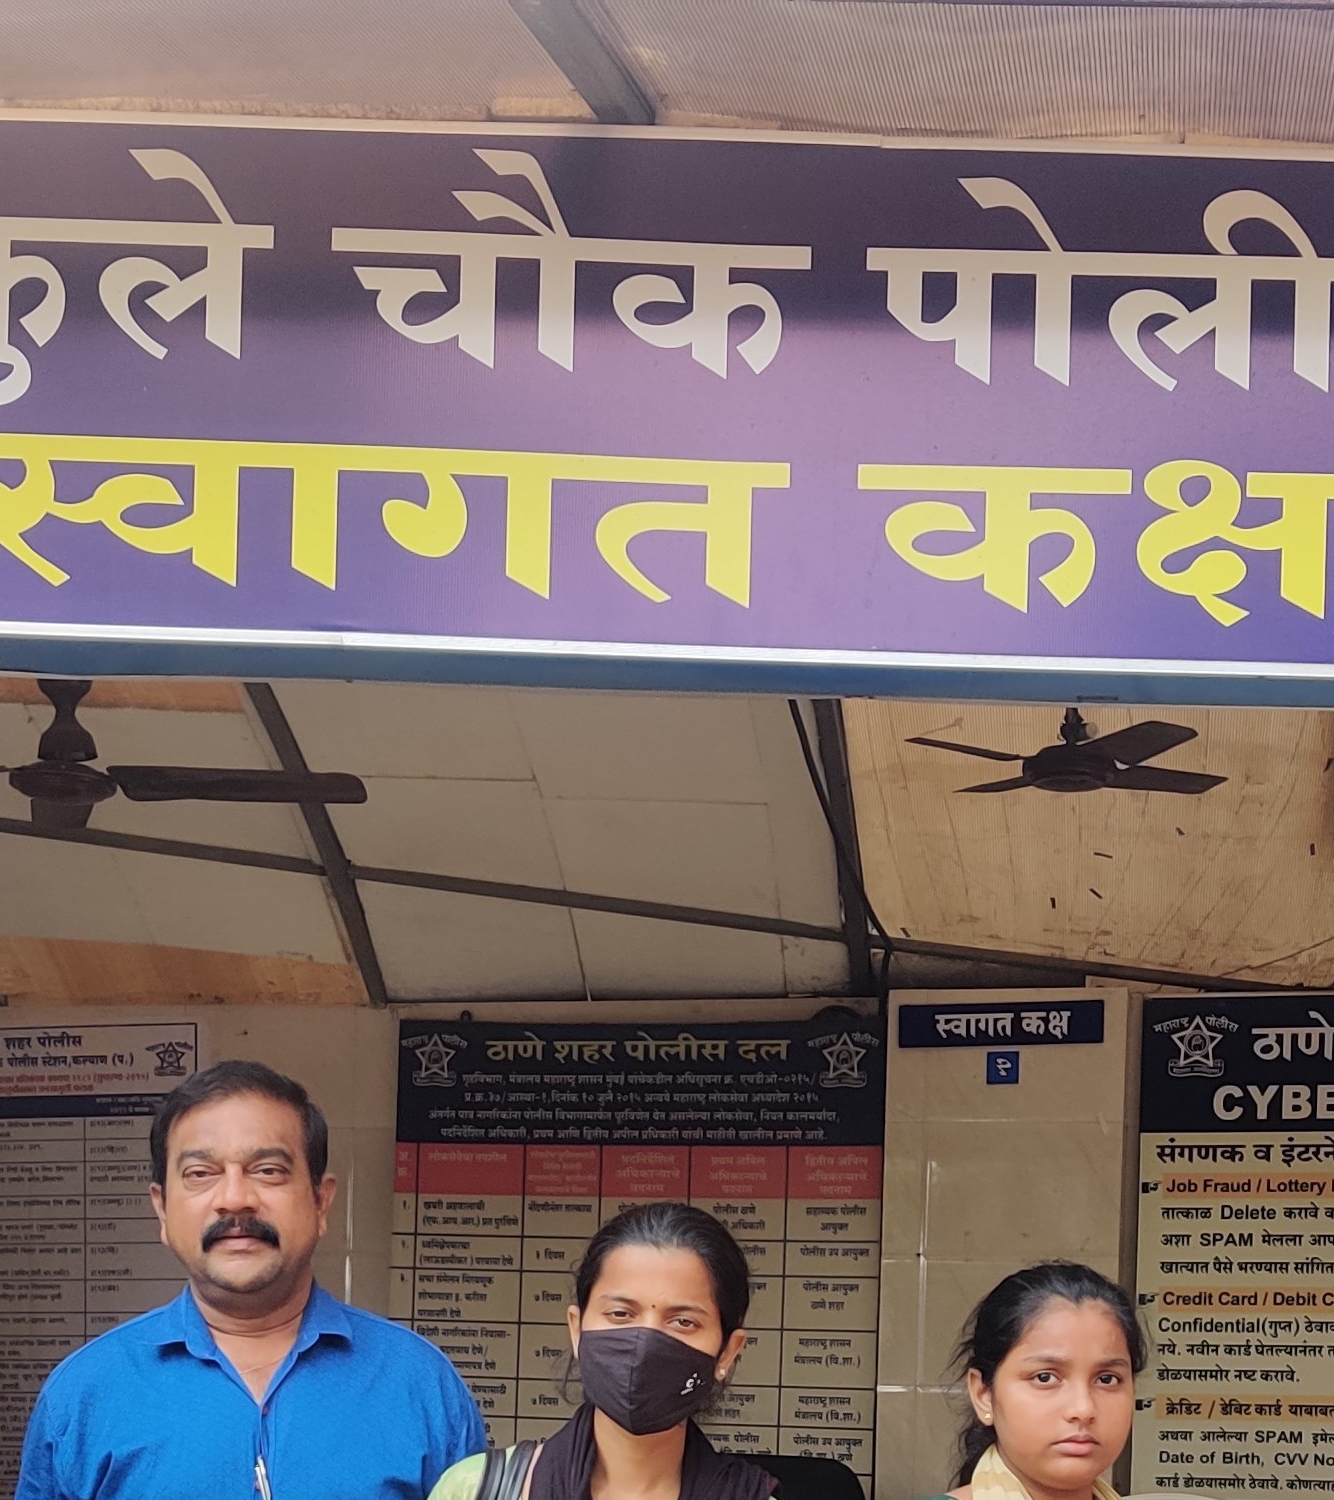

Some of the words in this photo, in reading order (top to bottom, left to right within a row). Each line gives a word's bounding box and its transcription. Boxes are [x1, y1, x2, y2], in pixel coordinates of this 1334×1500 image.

[332, 148, 813, 380] चौक
[934, 1012, 1014, 1039] स्वागत
[1020, 1010, 1071, 1040] कक्ष
[5, 1036, 32, 1050] शहर
[37, 1032, 83, 1048] पोलीस
[485, 1031, 546, 1062] ठाणे
[553, 1040, 616, 1064] शहर
[623, 1031, 728, 1062] पोलीस
[737, 1039, 791, 1063] दल
[1156, 1137, 1246, 1163] संगणक
[1253, 1143, 1274, 1162] व
[1166, 1179, 1198, 1193] Job
[1203, 1179, 1251, 1193] Fraud
[1266, 1179, 1326, 1197] Lottery
[1161, 1206, 1212, 1221] तात्काळ
[1221, 1205, 1276, 1220] Delete
[1283, 1202, 1319, 1221] करावे
[1324, 1208, 1334, 1220] व
[1161, 1234, 1192, 1247] अशा
[1200, 1233, 1253, 1247] SPAM
[1261, 1229, 1304, 1247] मेलला
[1160, 1260, 1209, 1275] खात्यात
[1213, 1256, 1233, 1275] पैसे
[1237, 1261, 1290, 1276] भरण्यास
[803, 1280, 828, 1292] पोलीस
[1163, 1292, 1214, 1307] Credit
[1218, 1292, 1258, 1307] Card
[1273, 1292, 1318, 1307] Debit
[1157, 1340, 1181, 1356] नये.
[1185, 1340, 1220, 1356] नवीन
[1224, 1340, 1252, 1357] कार्ड
[1255, 1340, 1323, 1358] घेतल्यानंतर
[1233, 1369, 1257, 1383] नष्ट
[1259, 1365, 1300, 1383] करावे.
[1165, 1397, 1202, 1416] क्रेडिट
[1219, 1397, 1252, 1416] डेबिट
[1254, 1398, 1283, 1417] कार्ड
[1158, 1430, 1193, 1442] अथवा
[1199, 1426, 1249, 1443] आलेल्या
[1254, 1431, 1304, 1444] SPAM
[1158, 1451, 1194, 1464] Date
[1200, 1450, 1216, 1464] of
[1222, 1451, 1265, 1468] Birth,
[1274, 1452, 1309, 1467] CVV
[1155, 1473, 1180, 1489] कार्ड
